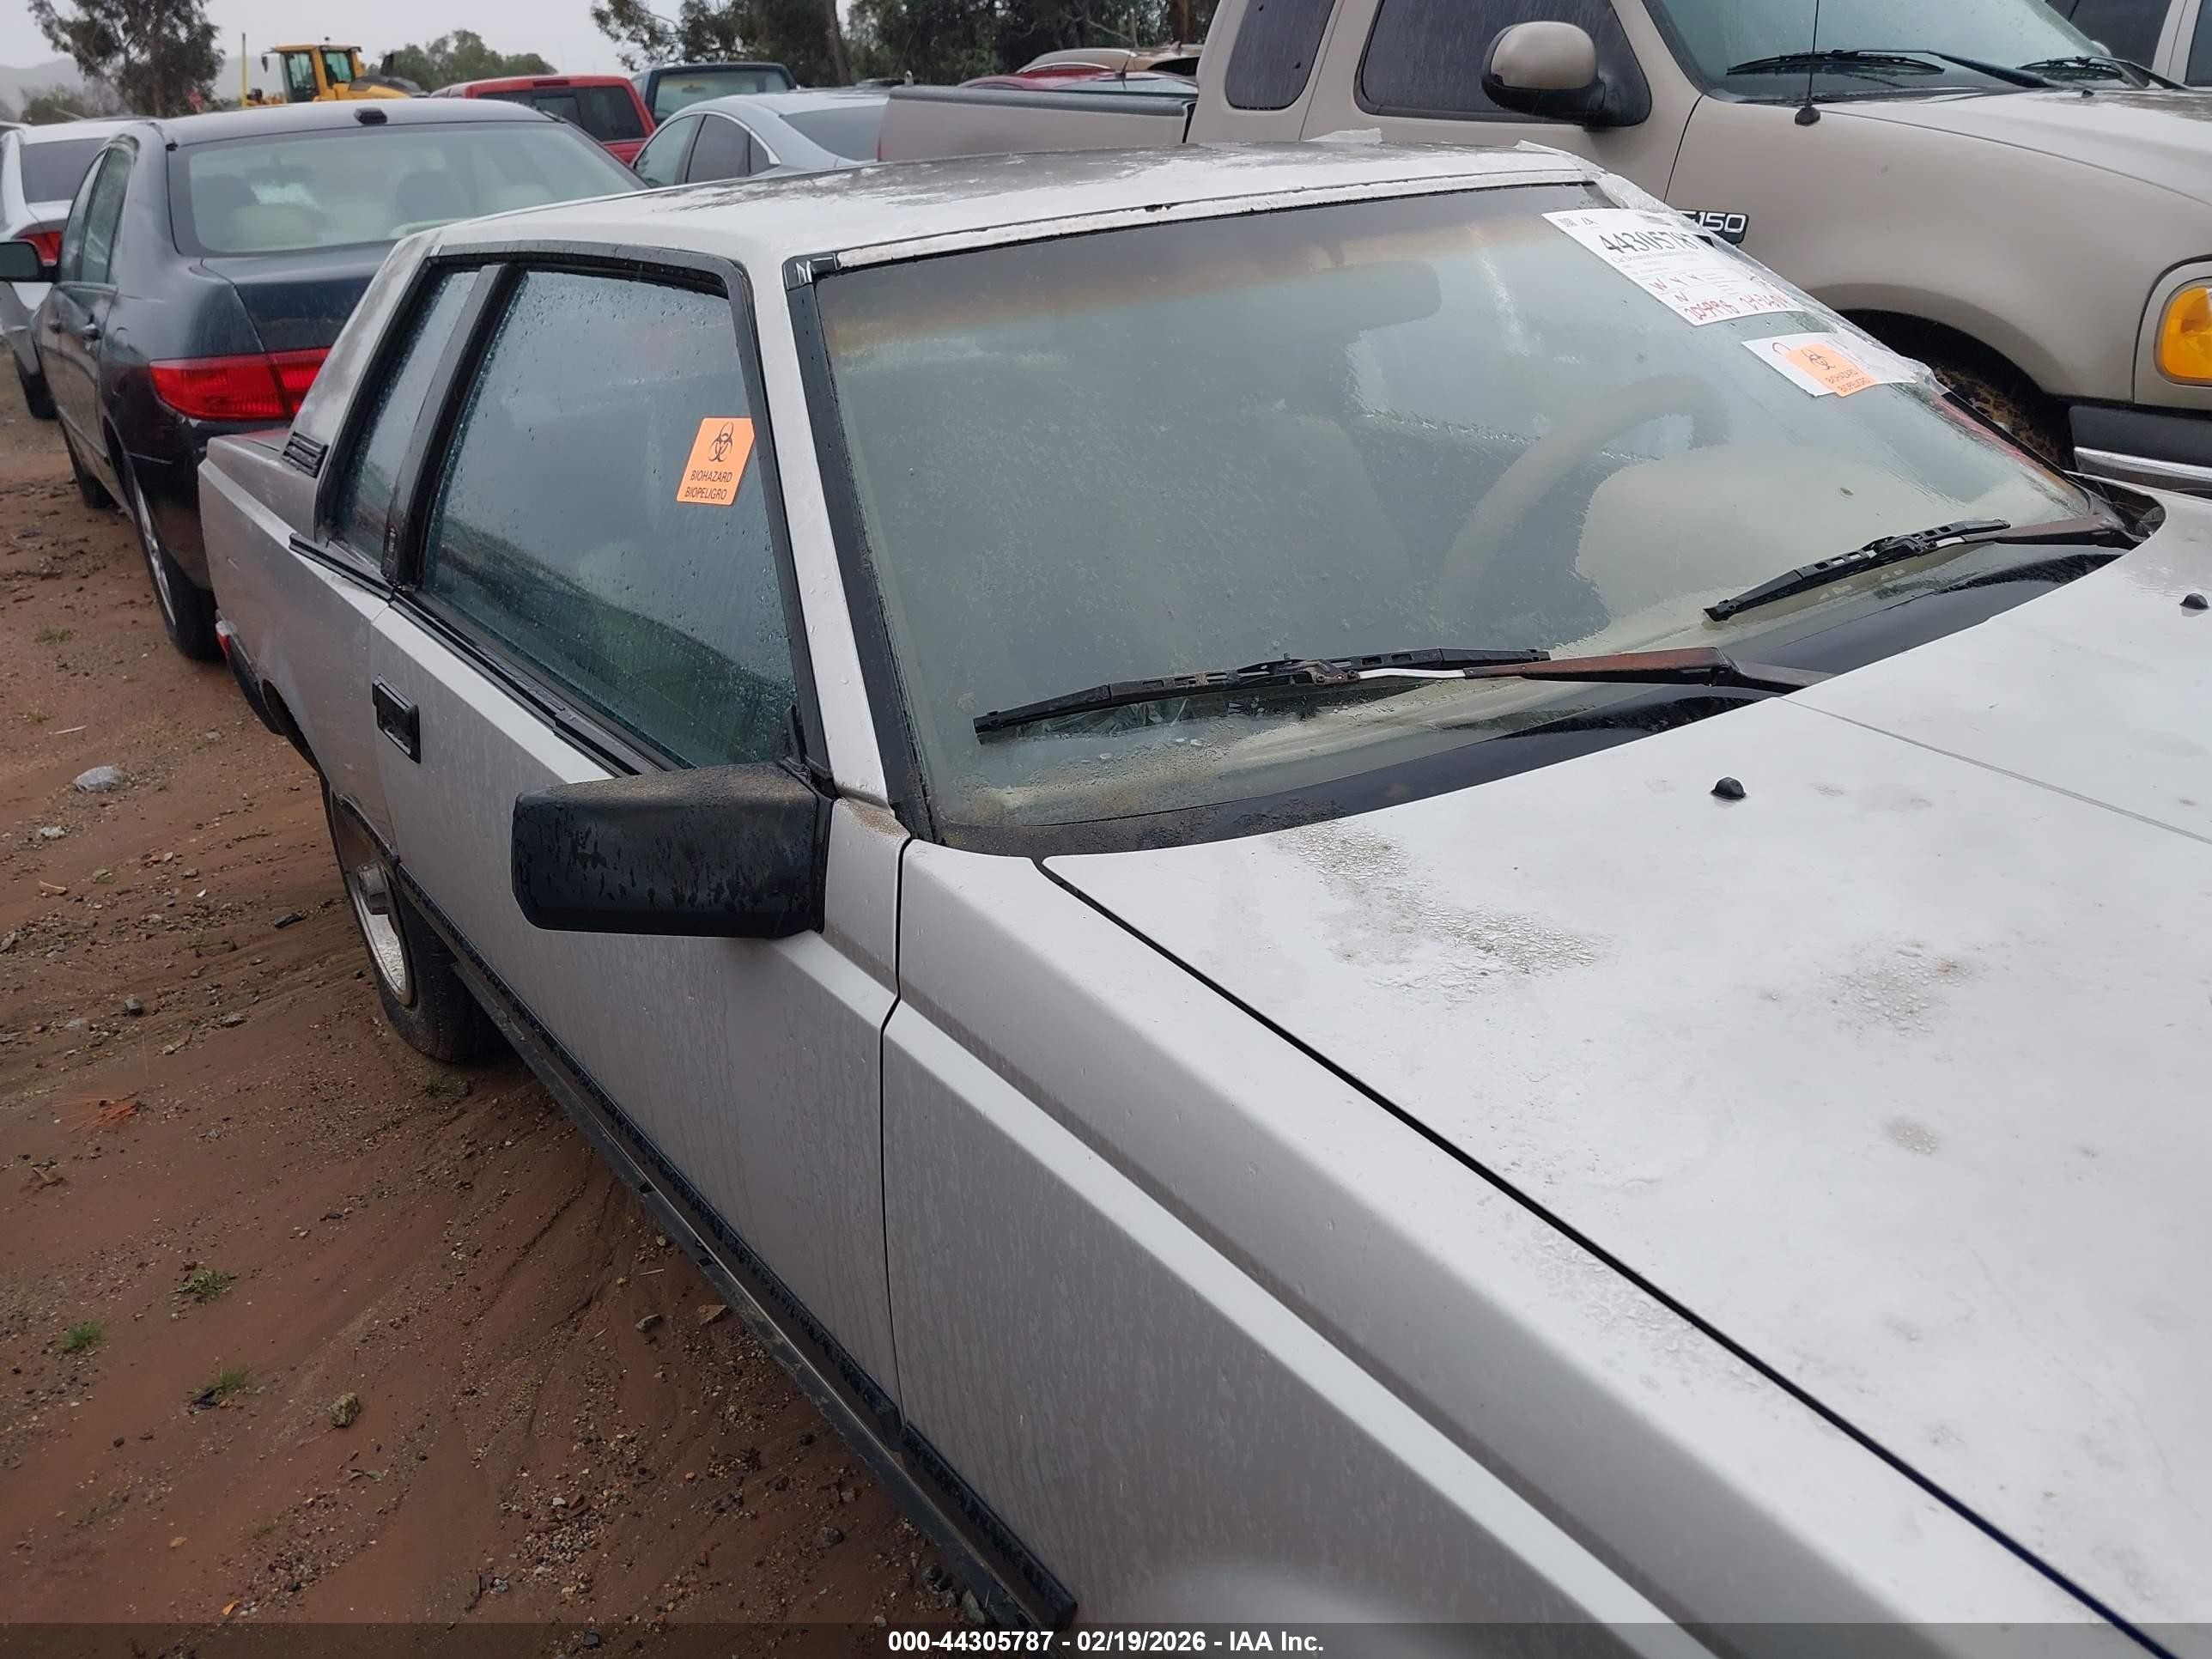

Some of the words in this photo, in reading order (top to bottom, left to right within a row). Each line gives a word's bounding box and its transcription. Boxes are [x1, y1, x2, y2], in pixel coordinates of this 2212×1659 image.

[1599, 230, 1708, 253] 44305787
[690, 470, 732, 483] BIOHAZARD
[684, 486, 727, 501] BIOPELIGRO
